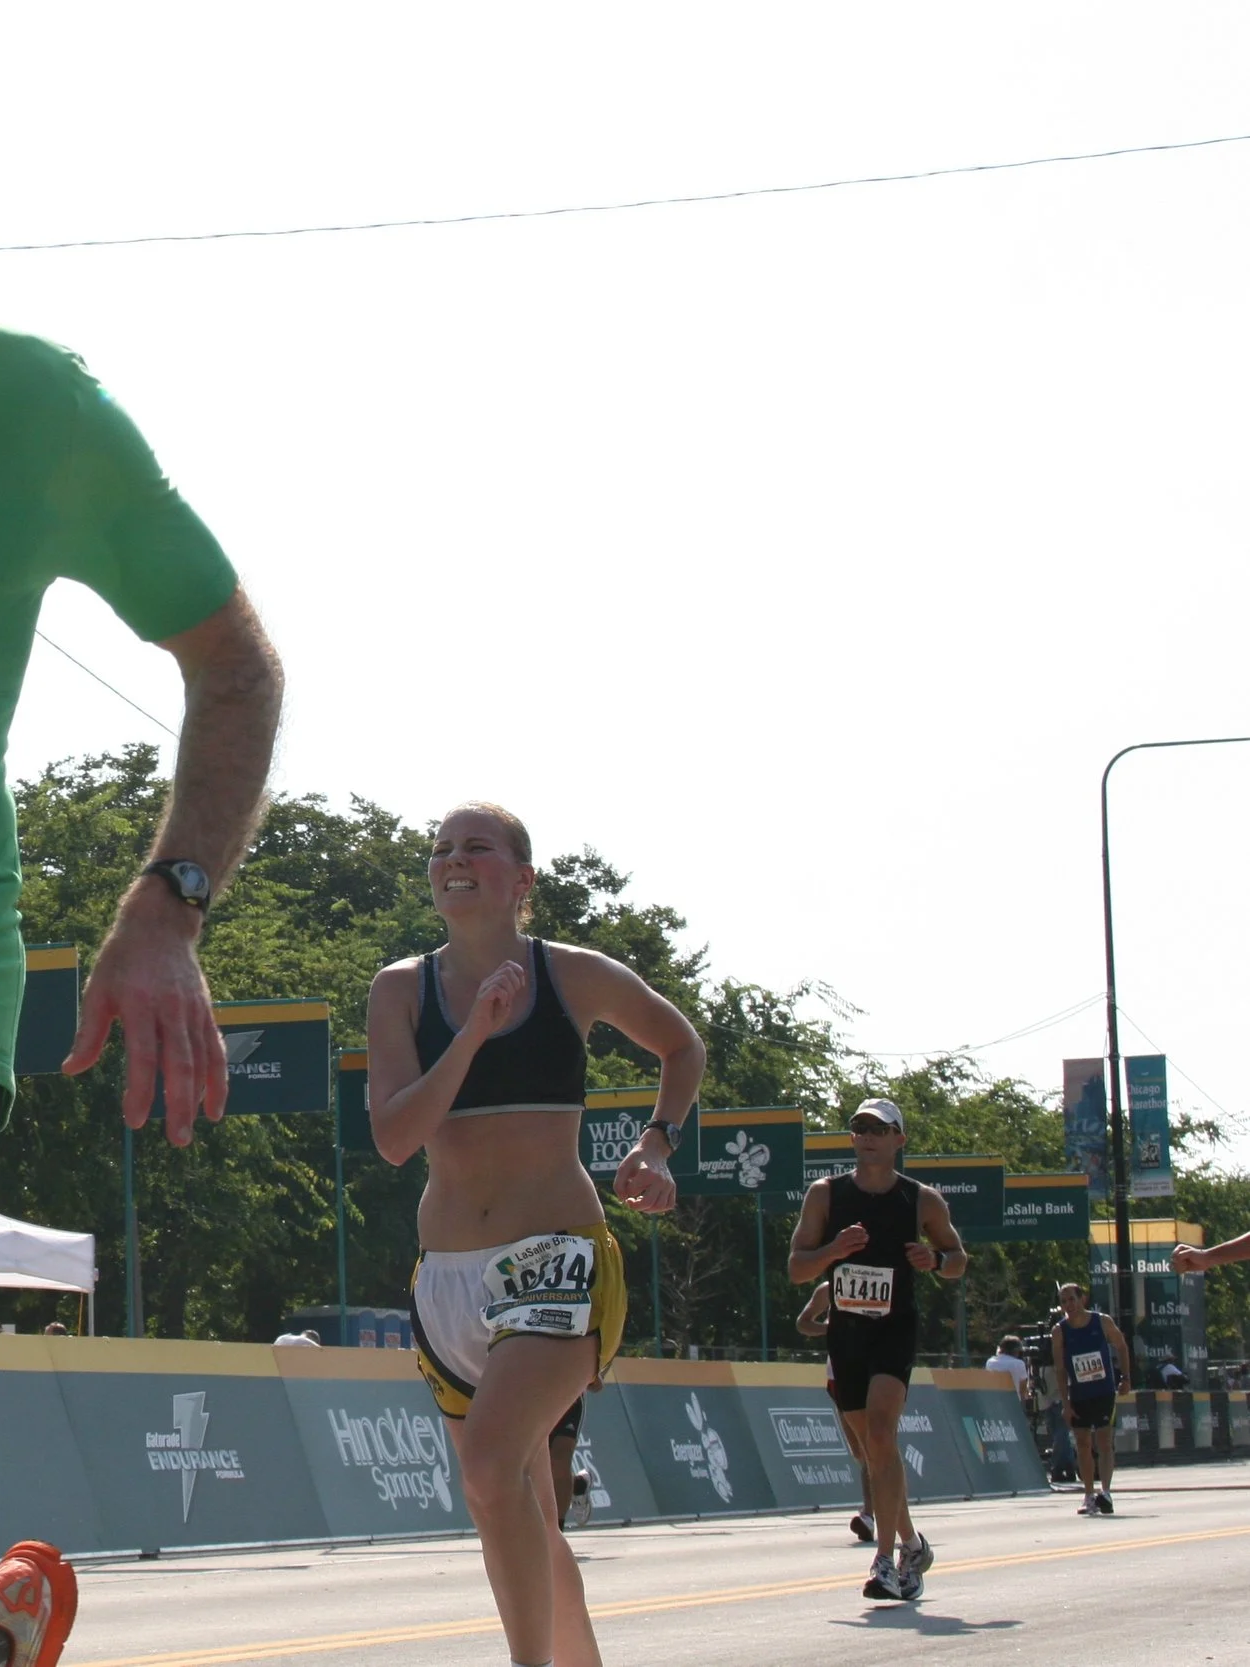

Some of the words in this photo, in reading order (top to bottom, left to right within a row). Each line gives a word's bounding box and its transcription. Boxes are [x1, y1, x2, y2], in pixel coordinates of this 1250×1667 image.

[587, 1119, 645, 1142] WHOL
[1004, 1203, 1043, 1216] aSalle
[1045, 1201, 1075, 1215] Bank
[514, 1240, 552, 1263] LaSalle
[1136, 1259, 1171, 1274] Bank
[835, 1276, 844, 1297] A
[849, 1278, 890, 1302] 1410
[1081, 1358, 1103, 1372] 1199
[146, 1432, 181, 1448] Gatorade
[327, 1407, 451, 1482] Hinckley
[147, 1449, 243, 1470] ENDURANCE
[371, 1466, 436, 1510] Springs
